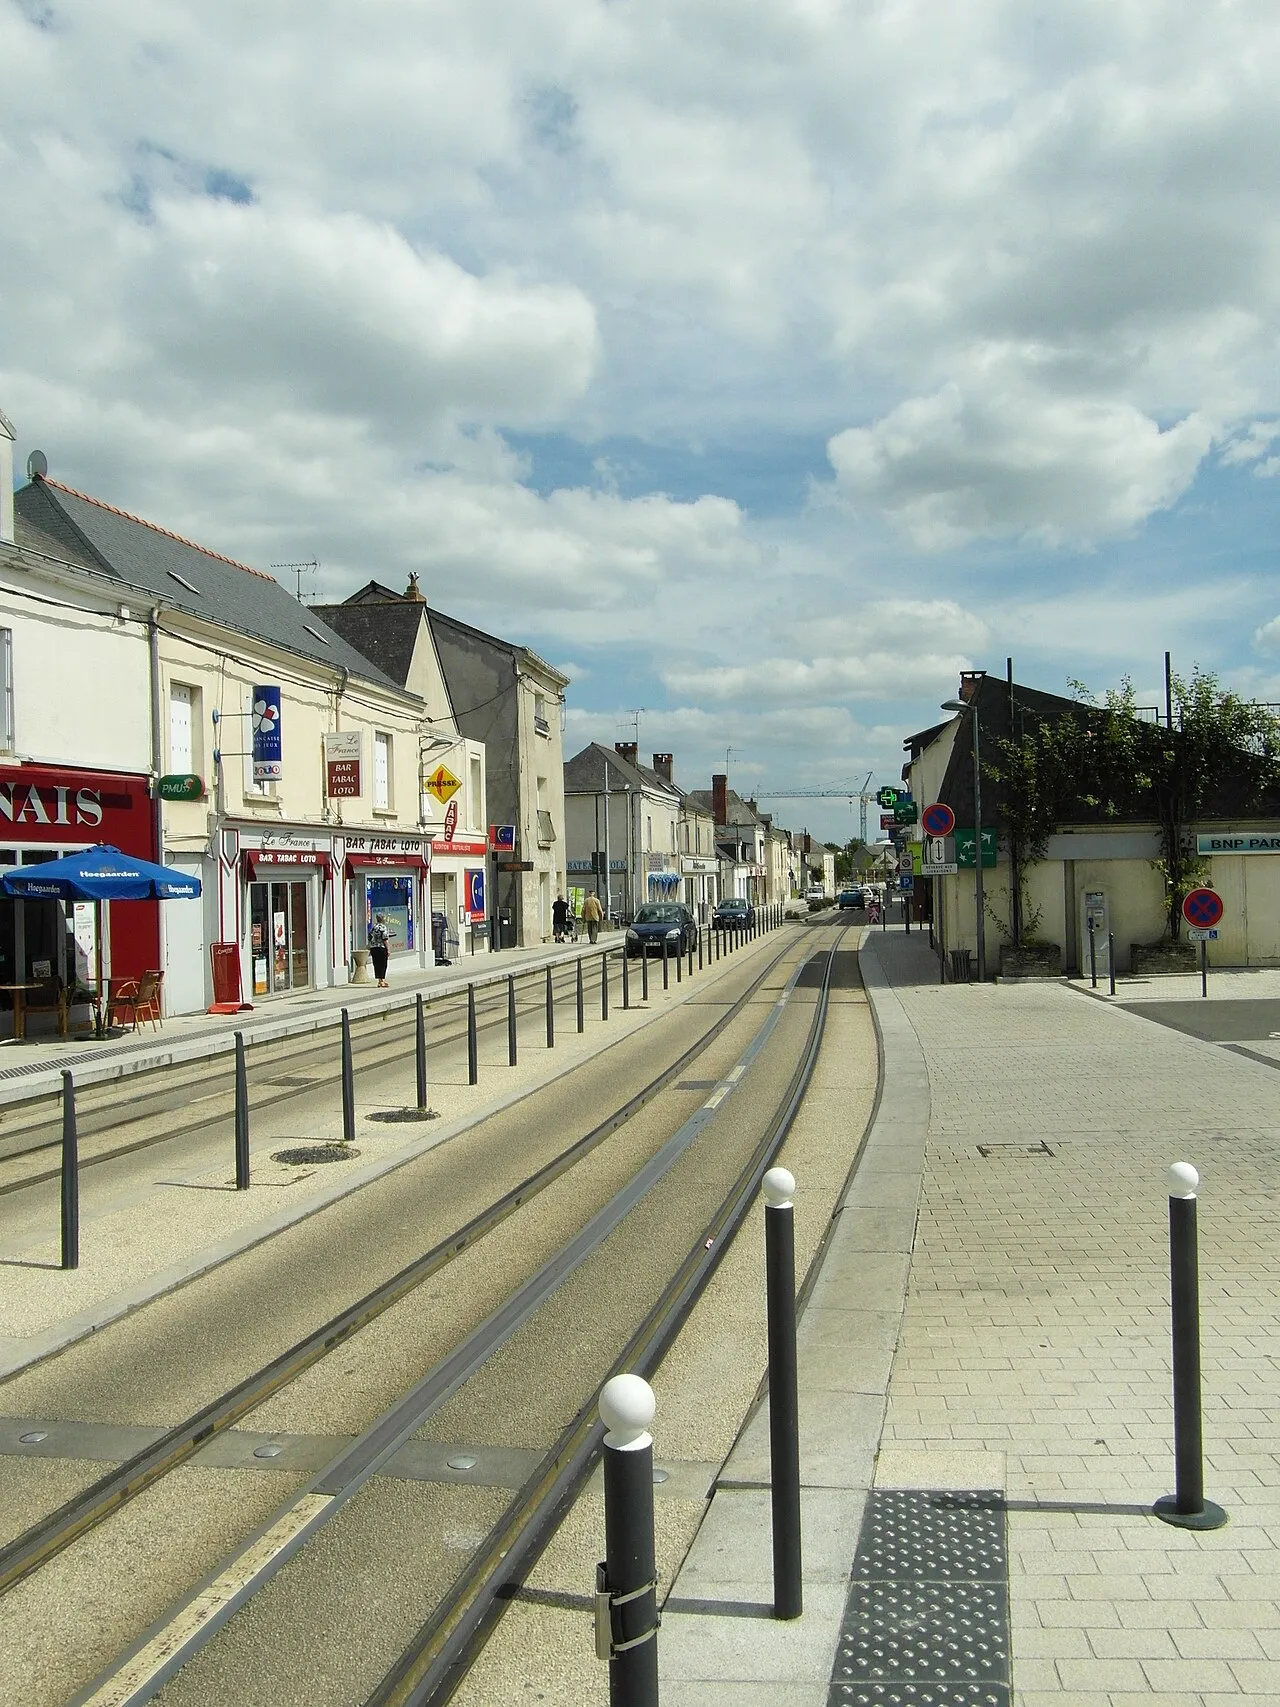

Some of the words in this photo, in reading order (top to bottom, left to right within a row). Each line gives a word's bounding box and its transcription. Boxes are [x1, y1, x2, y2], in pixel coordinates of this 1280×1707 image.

[346, 735, 358, 744] Le
[335, 764, 352, 772] BAR
[332, 775, 357, 783] TABAC
[162, 784, 184, 793] PMU
[427, 780, 457, 788] PRESSE
[333, 786, 355, 795] LOTO
[0, 781, 103, 827] NAIS
[445, 802, 456, 840] TABAC
[262, 830, 276, 846] Le
[278, 832, 310, 847] France
[345, 837, 365, 849] BAR
[370, 838, 397, 850] TABAC
[400, 840, 420, 851] LOTO
[1211, 839, 1244, 849] BNP
[1249, 838, 1280, 848] PAR
[259, 853, 274, 863] BAR
[276, 854, 297, 863] TABAC
[300, 855, 317, 863] LOTO
[80, 871, 140, 879] Hoegaarden
[27, 882, 61, 894] Hoegaarden
